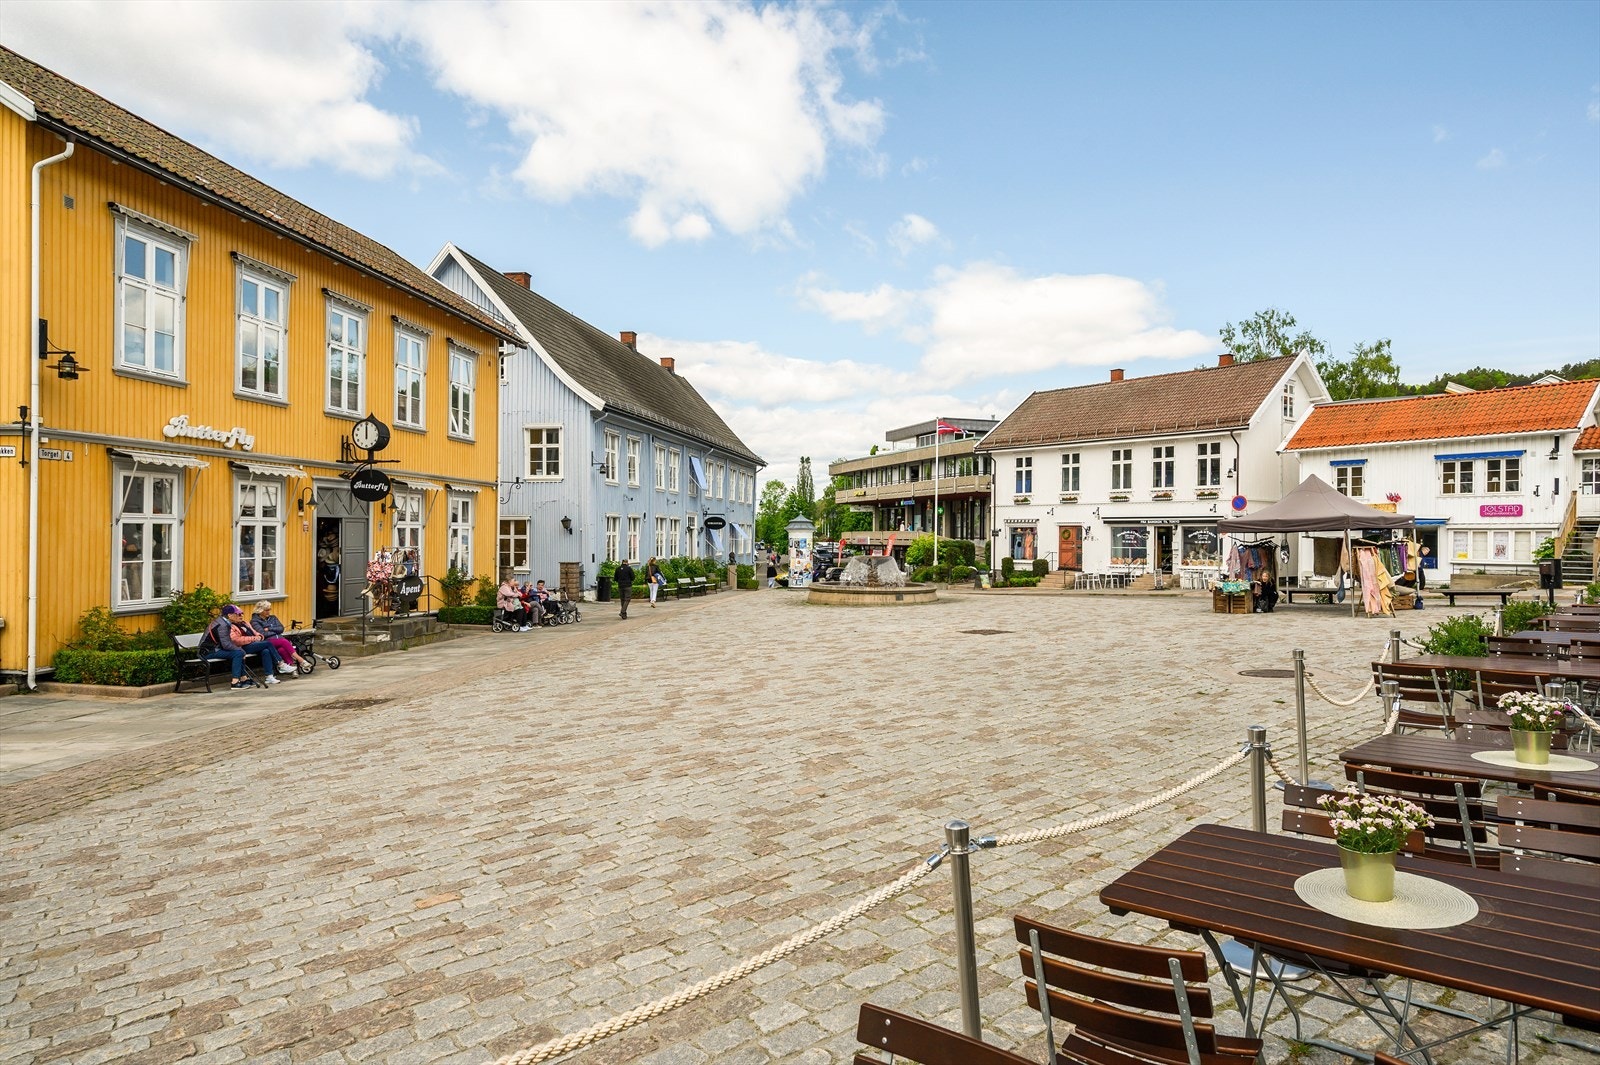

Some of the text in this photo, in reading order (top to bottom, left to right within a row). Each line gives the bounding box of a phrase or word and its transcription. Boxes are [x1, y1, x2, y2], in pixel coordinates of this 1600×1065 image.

[163, 415, 255, 450] Butterfly
[41, 450, 59, 458] Torget
[353, 480, 389, 491] Butterfly
[400, 582, 420, 596] Åpent
